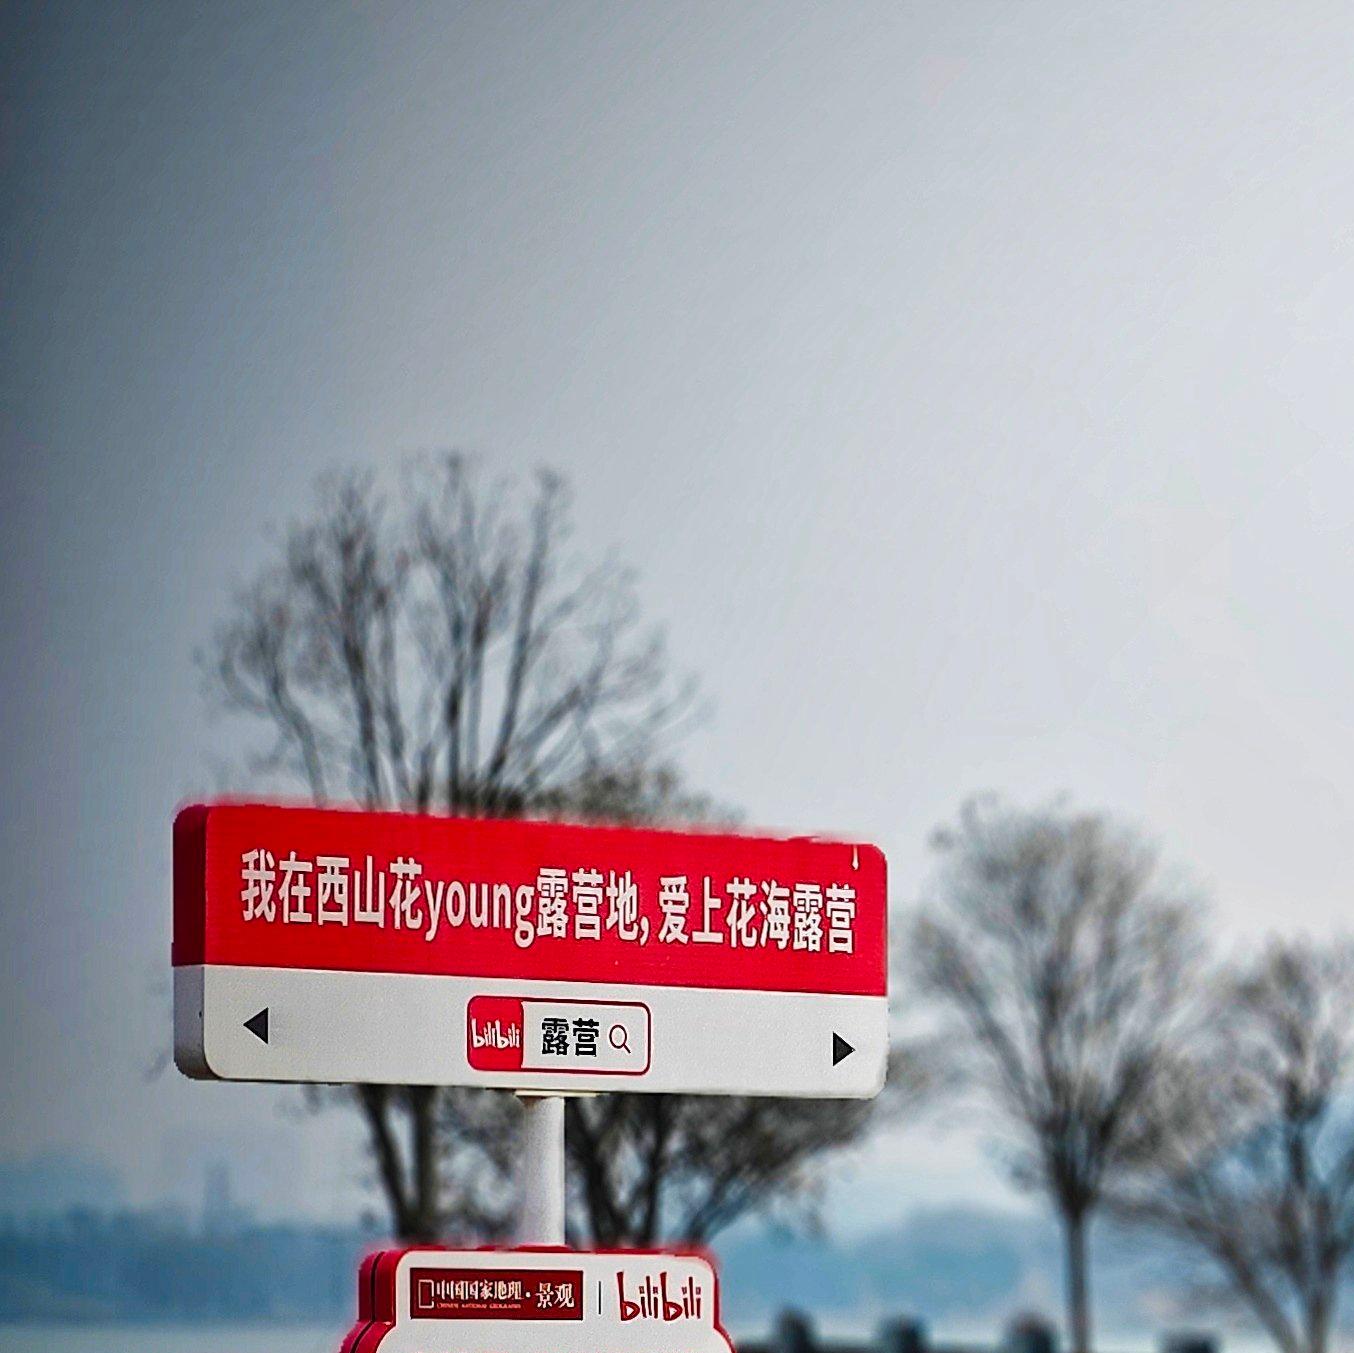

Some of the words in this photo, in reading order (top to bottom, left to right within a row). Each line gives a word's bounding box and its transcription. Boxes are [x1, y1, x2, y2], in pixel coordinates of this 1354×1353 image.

[470, 1018, 520, 1048] bilibili
[541, 1018, 599, 1056] 露营
[616, 1271, 701, 1321] bilibili
